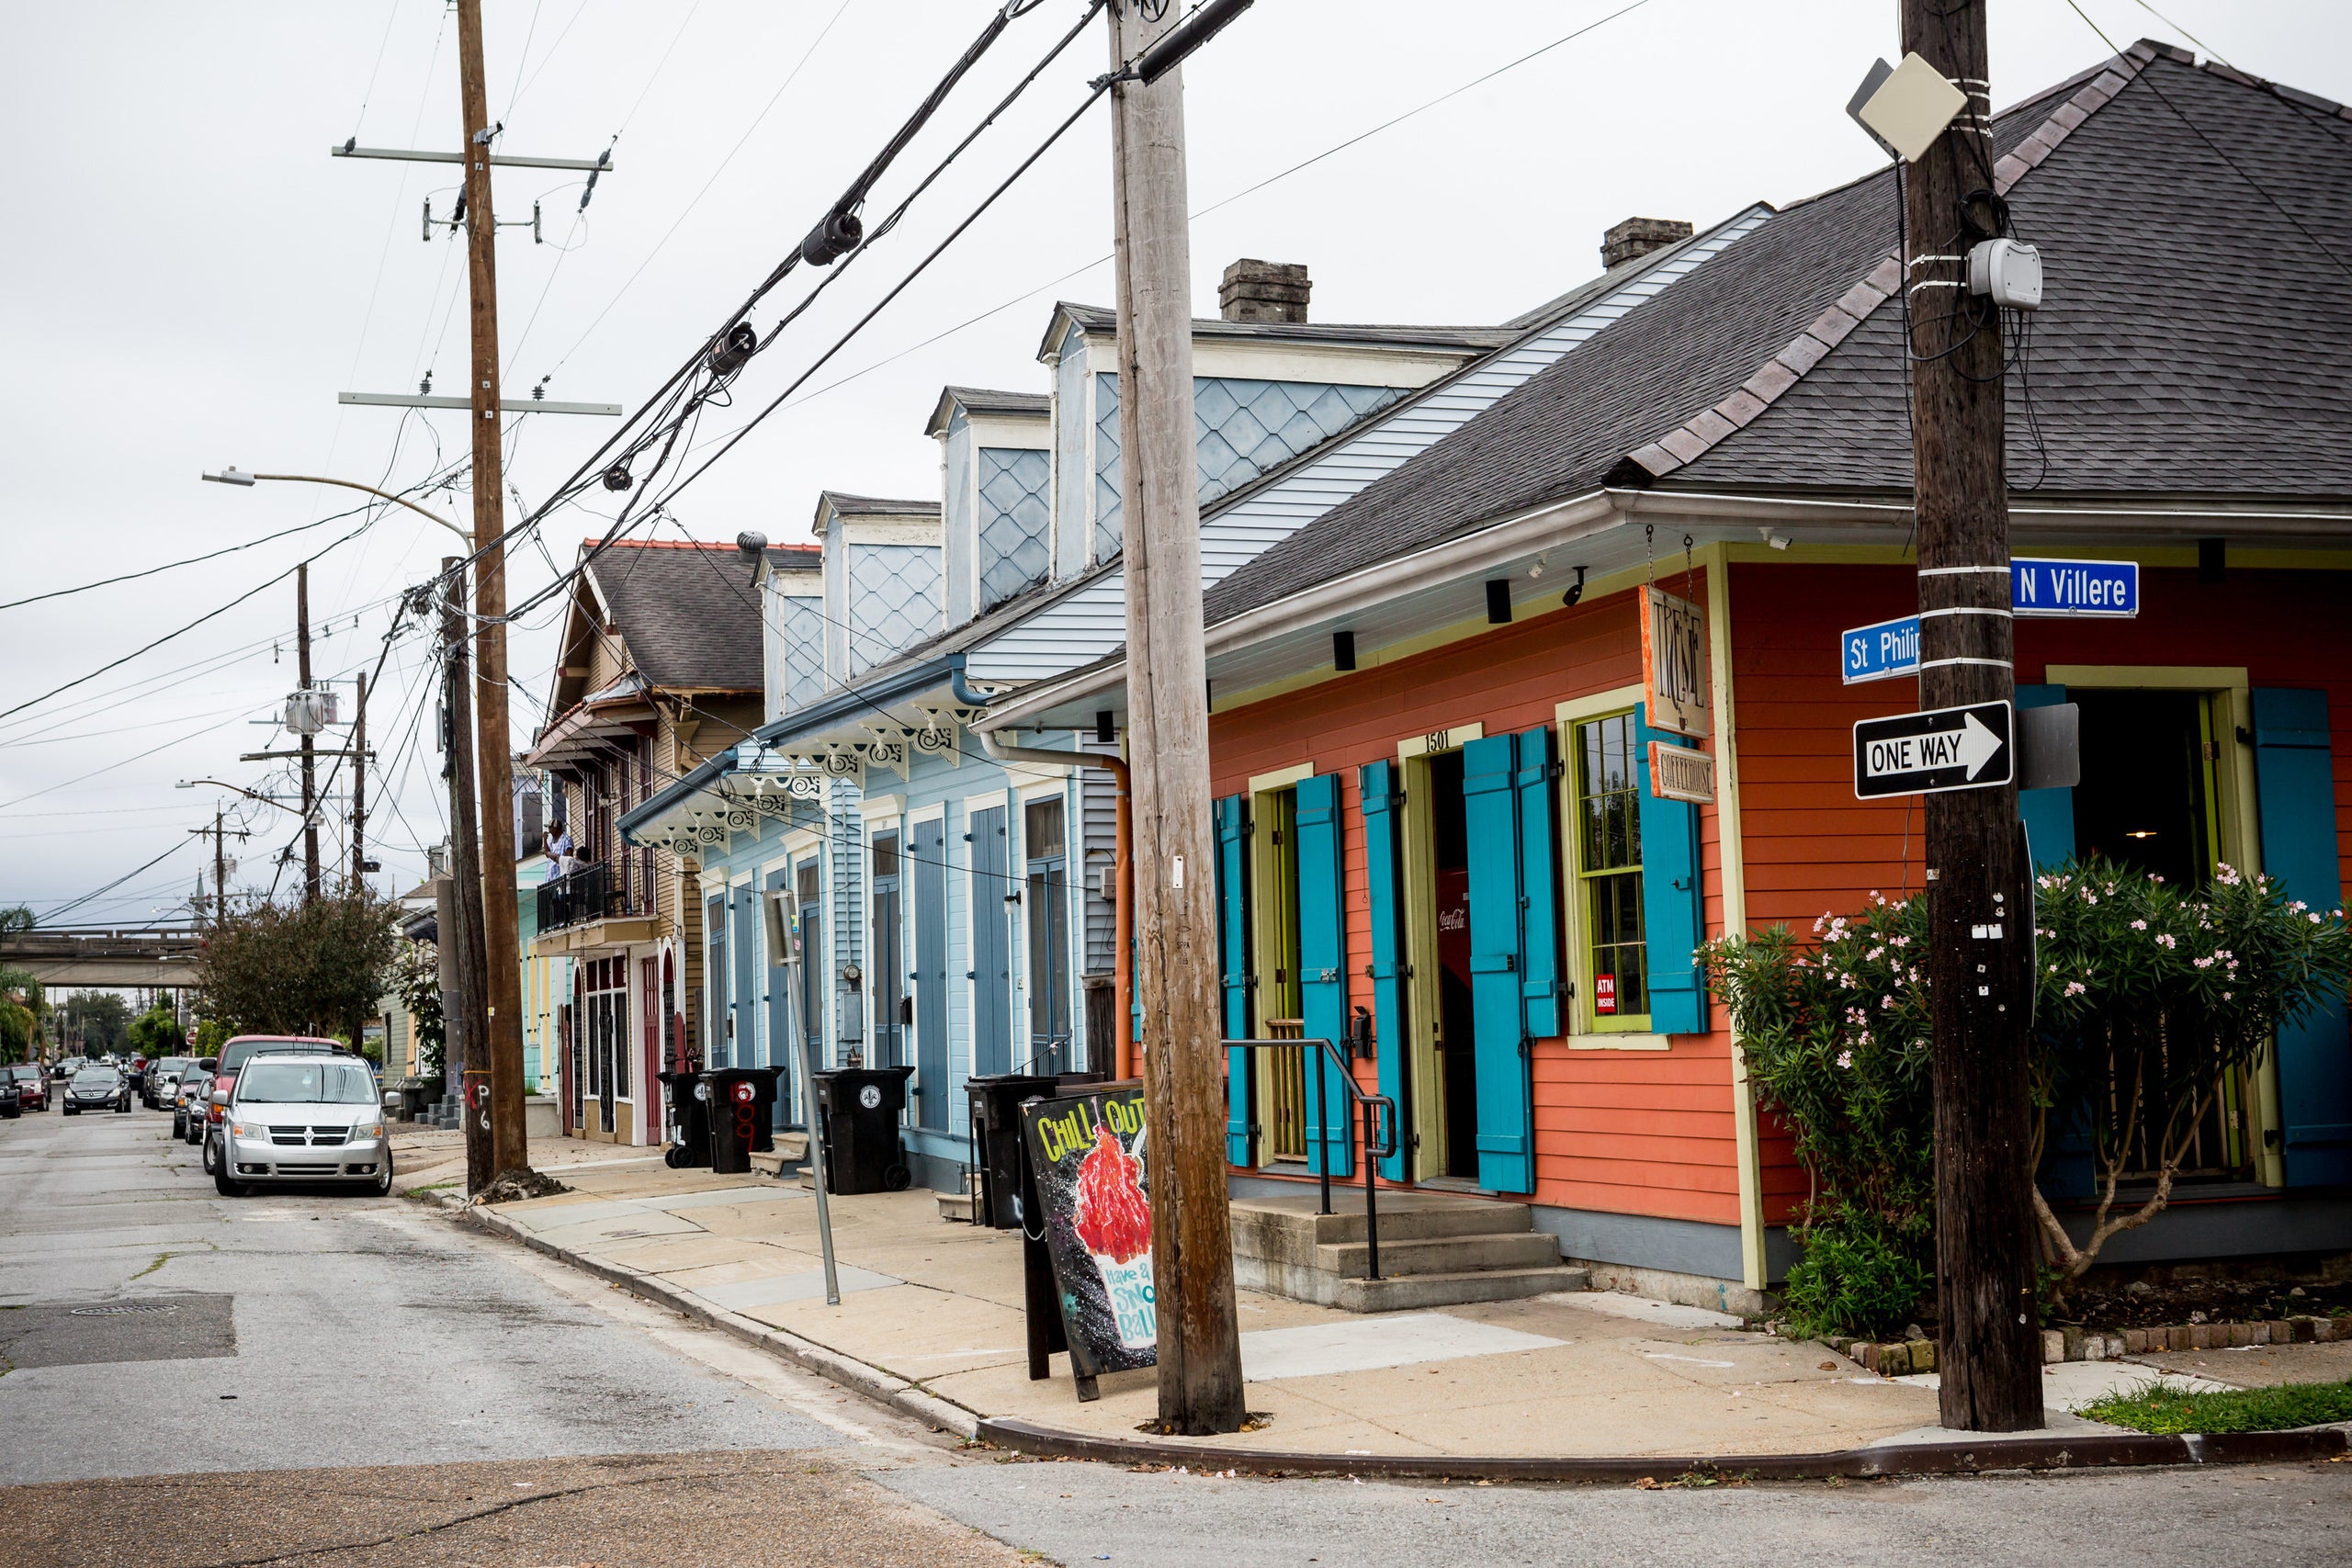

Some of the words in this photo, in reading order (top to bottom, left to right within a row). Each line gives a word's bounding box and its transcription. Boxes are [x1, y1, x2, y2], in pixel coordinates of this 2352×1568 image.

[2020, 568, 2036, 603] N
[2051, 569, 2126, 606] Villere
[1850, 637, 1869, 670] St
[1425, 729, 1450, 752] 1501
[1871, 740, 1913, 773] ONE
[1919, 733, 1962, 766] WAY
[1660, 753, 1712, 794] COFFEEHOUSE
[1598, 979, 1614, 993] ATM
[1598, 998, 1614, 1008] INSIDE
[1139, 1263, 1150, 1280] a
[1114, 1283, 1155, 1312] SNO
